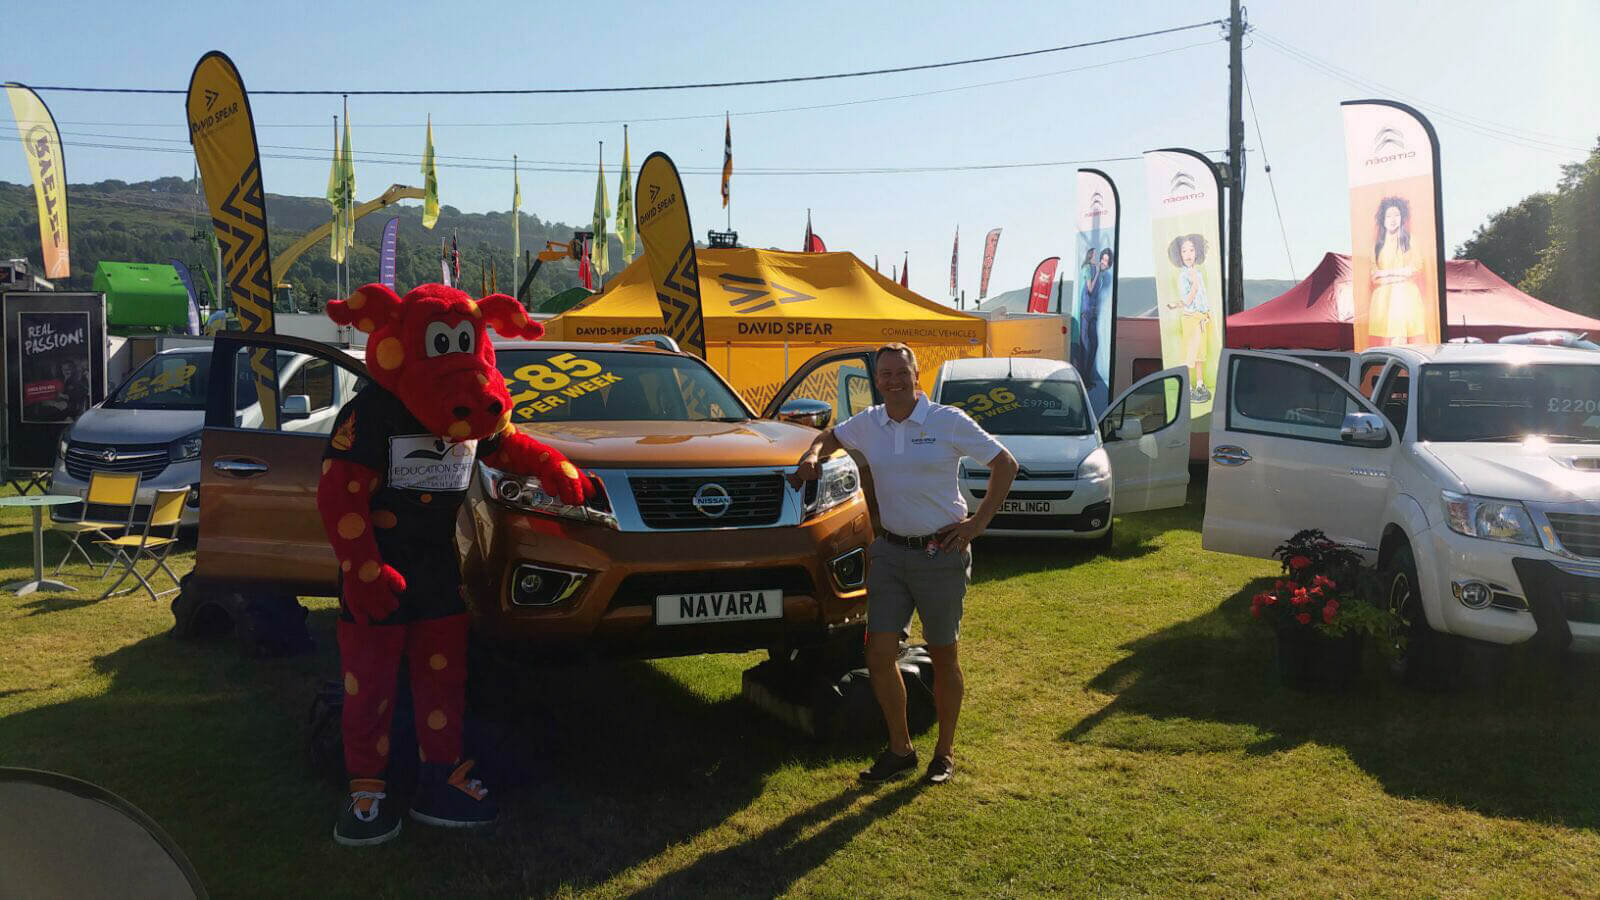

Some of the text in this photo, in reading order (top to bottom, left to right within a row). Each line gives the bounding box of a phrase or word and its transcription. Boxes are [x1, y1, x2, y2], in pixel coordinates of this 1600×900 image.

[215, 102, 239, 123] SPEAR
[640, 207, 657, 225] DAVID
[657, 193, 676, 213] SPEAR
[28, 323, 57, 338] REAL
[737, 322, 833, 335] DAVID SPEAR
[881, 327, 977, 338] COMMERCIAL VEHICLES
[25, 328, 84, 355] PASSION!
[516, 371, 624, 419] PER WEEK
[952, 387, 1016, 412] 36
[984, 402, 1021, 417] WEEK
[1548, 398, 1600, 412] £220
[394, 463, 451, 476] EDUCATION
[680, 592, 767, 618] NAVARA
